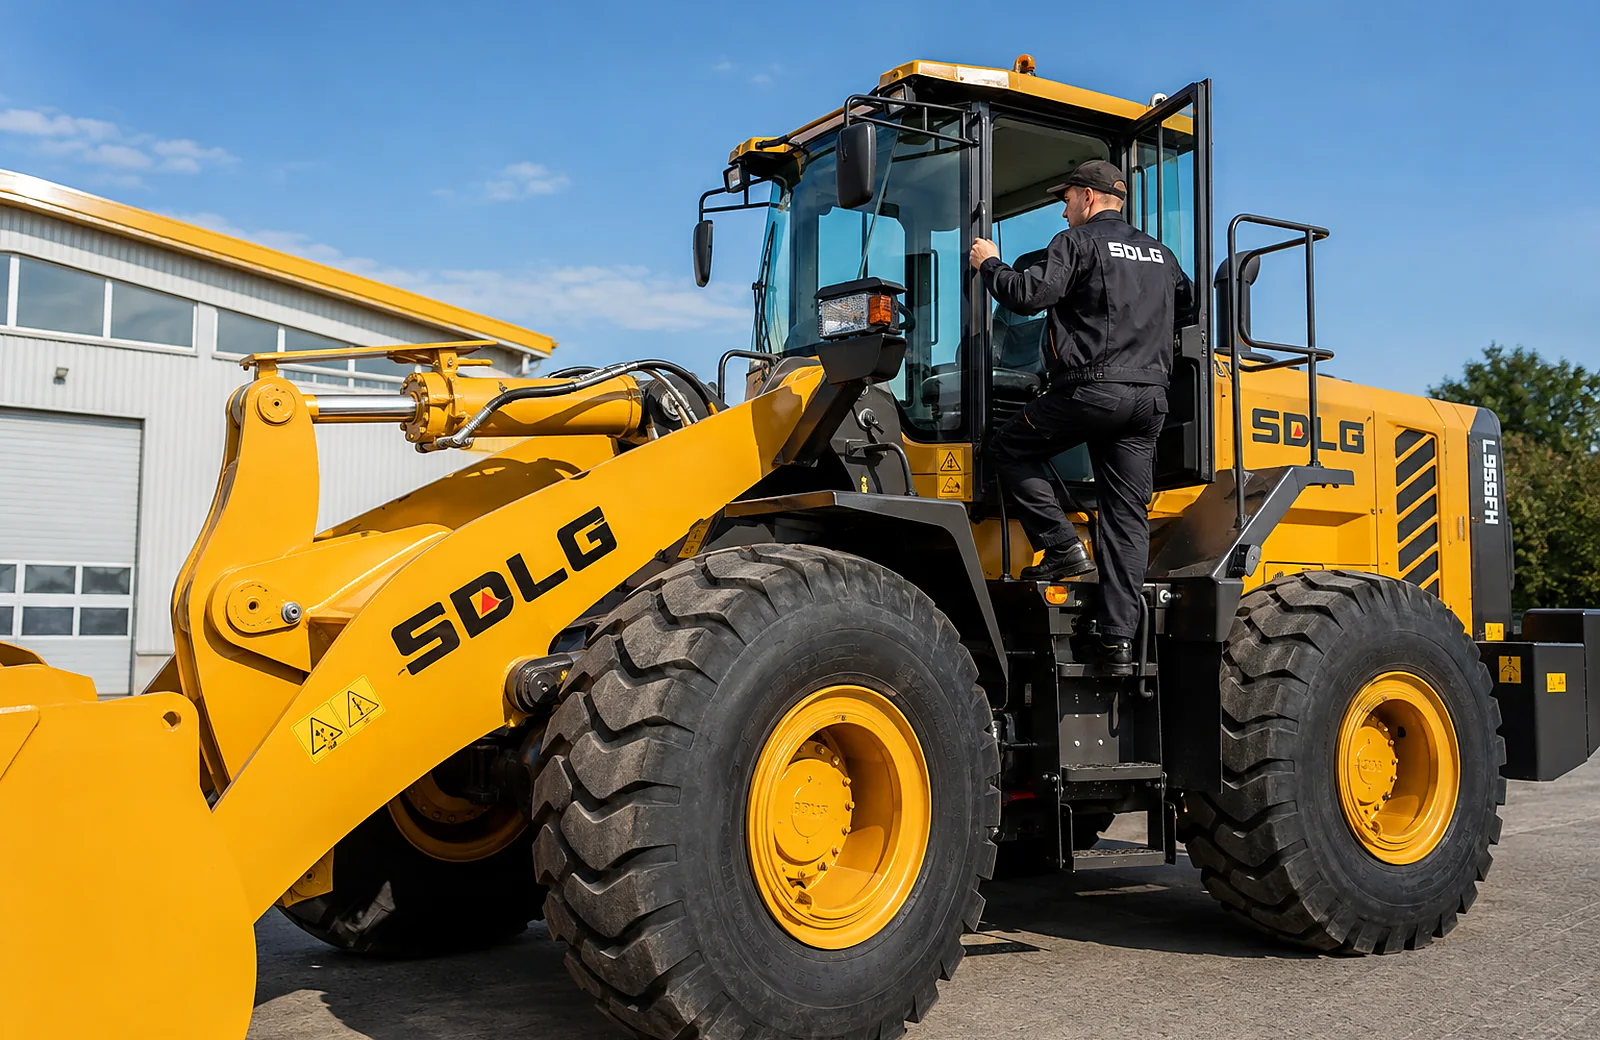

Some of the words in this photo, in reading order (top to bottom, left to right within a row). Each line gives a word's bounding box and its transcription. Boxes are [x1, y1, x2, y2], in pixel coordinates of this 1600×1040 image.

[1107, 241, 1165, 264] SDLG
[1252, 408, 1365, 455] SDLG
[391, 506, 617, 676] SDLG
